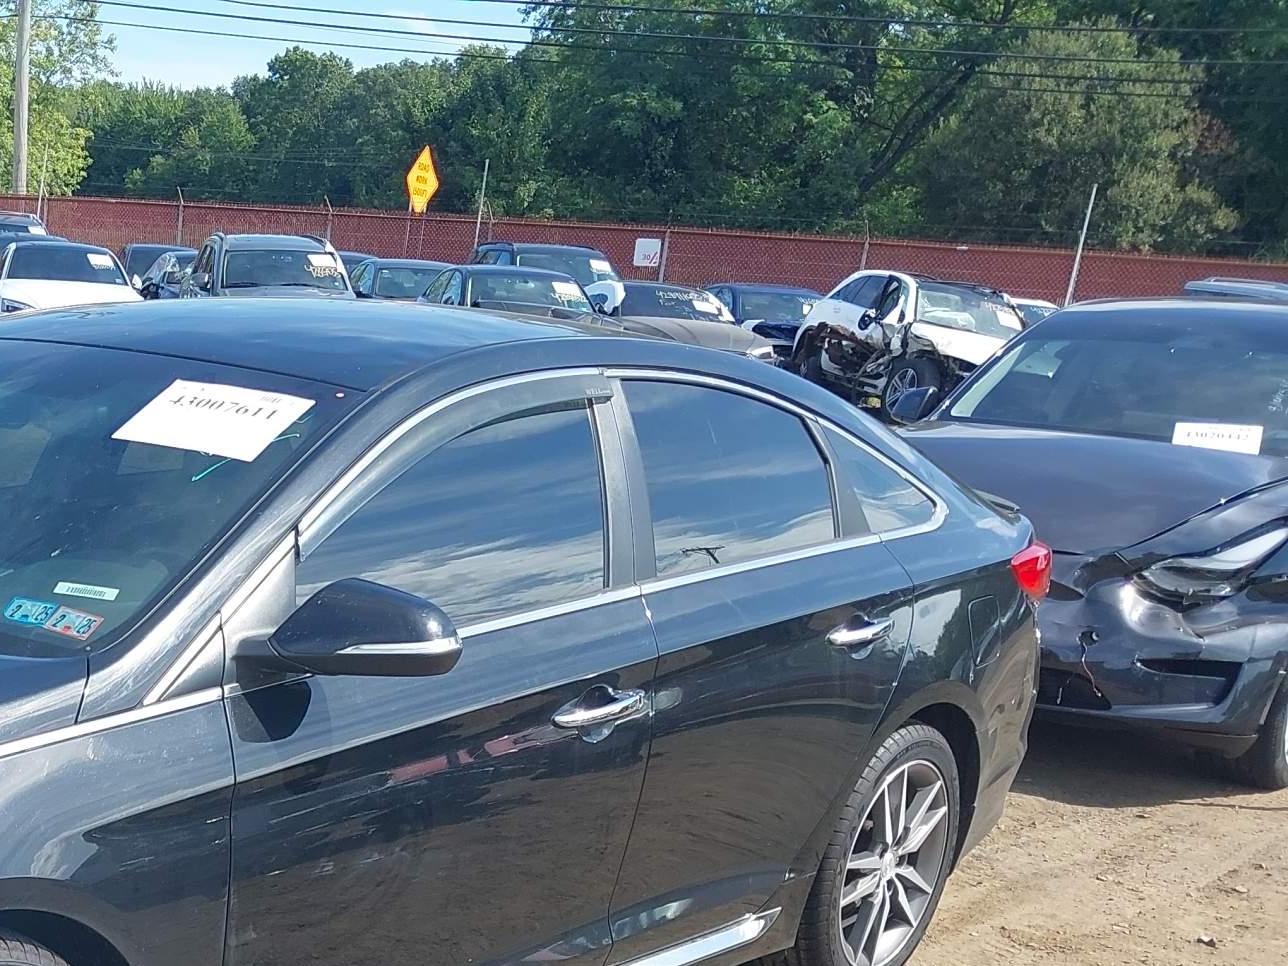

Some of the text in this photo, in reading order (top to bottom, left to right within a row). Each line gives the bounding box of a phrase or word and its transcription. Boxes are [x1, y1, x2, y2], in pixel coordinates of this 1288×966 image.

[169, 395, 279, 420] 43007611
[9, 604, 23, 617] 2
[51, 614, 67, 627] 2
